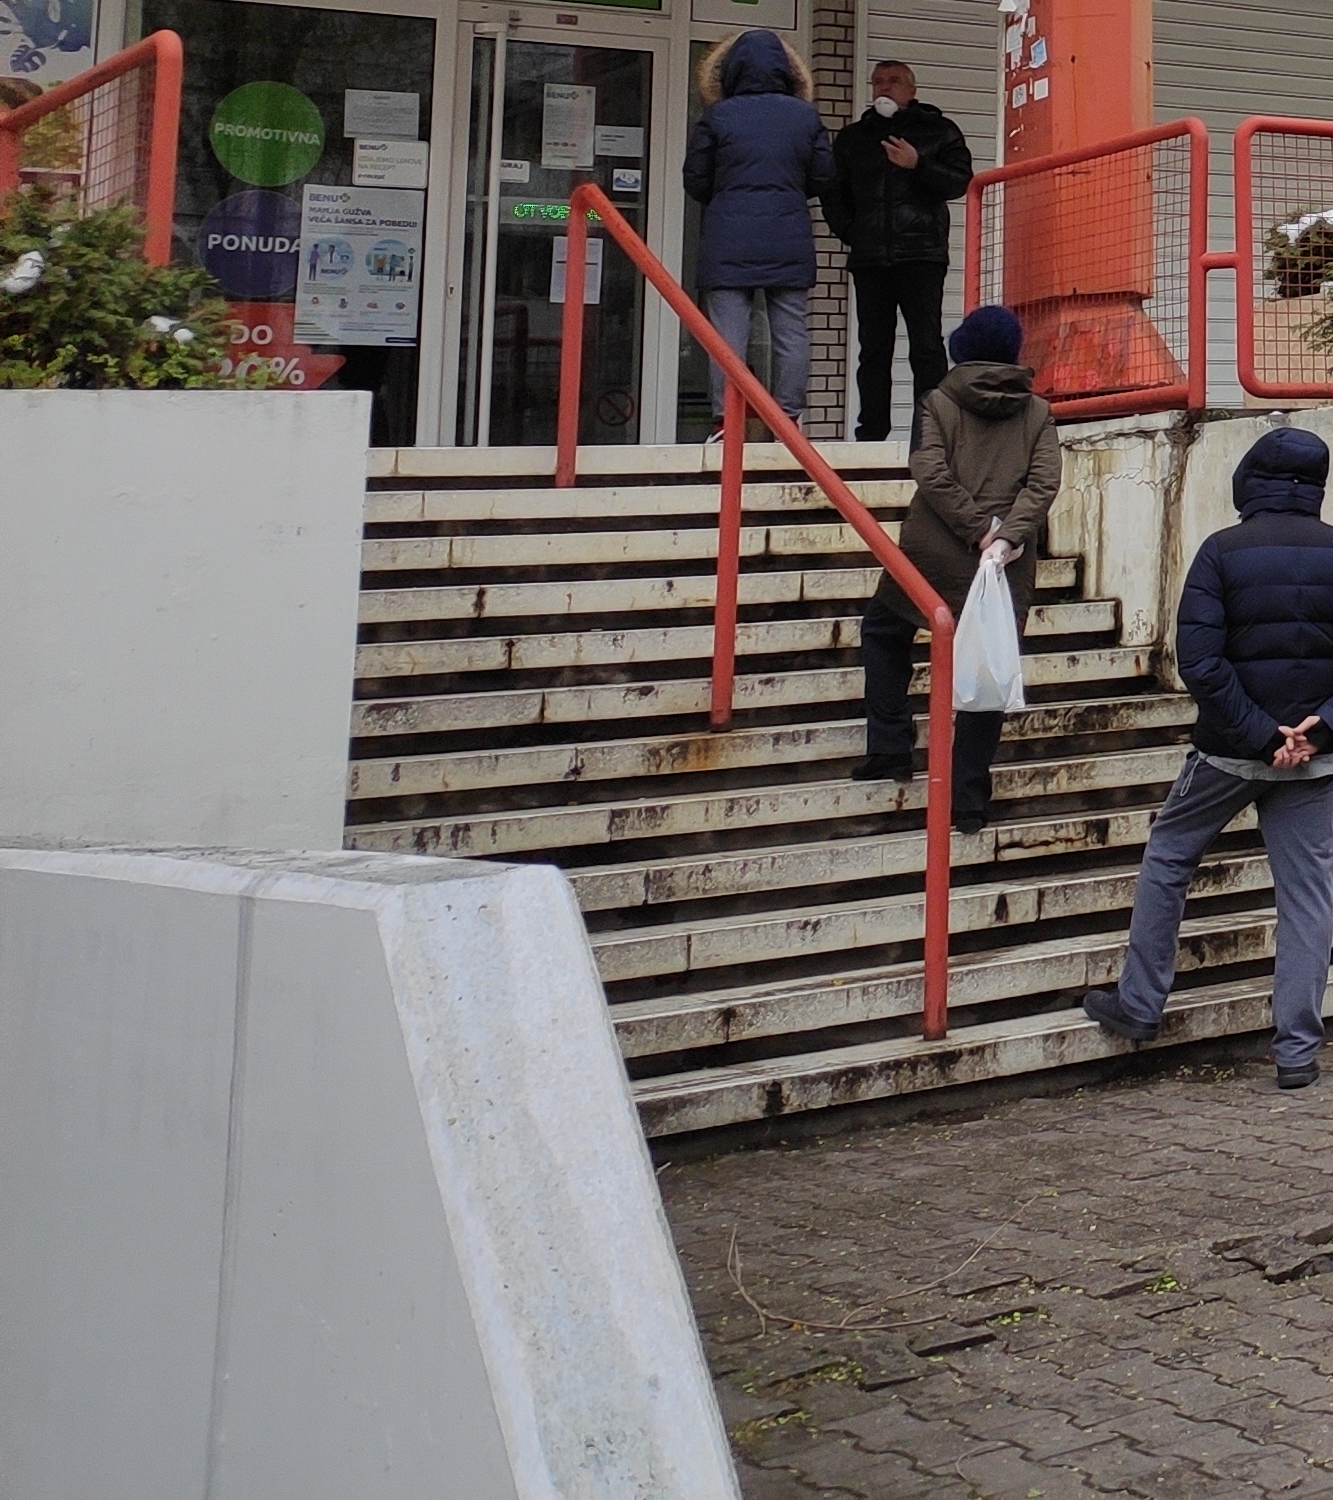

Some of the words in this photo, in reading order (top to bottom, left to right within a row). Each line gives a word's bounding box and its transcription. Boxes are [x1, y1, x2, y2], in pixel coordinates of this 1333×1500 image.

[214, 122, 321, 146] PROMOTIVNA
[500, 162, 524, 170] URAJ
[309, 193, 339, 203] BENU
[342, 206, 372, 216] GUŽVA
[308, 215, 331, 223] VEĆA
[365, 218, 377, 226] ZA
[207, 233, 301, 254] PONUDA
[230, 324, 273, 346] DO
